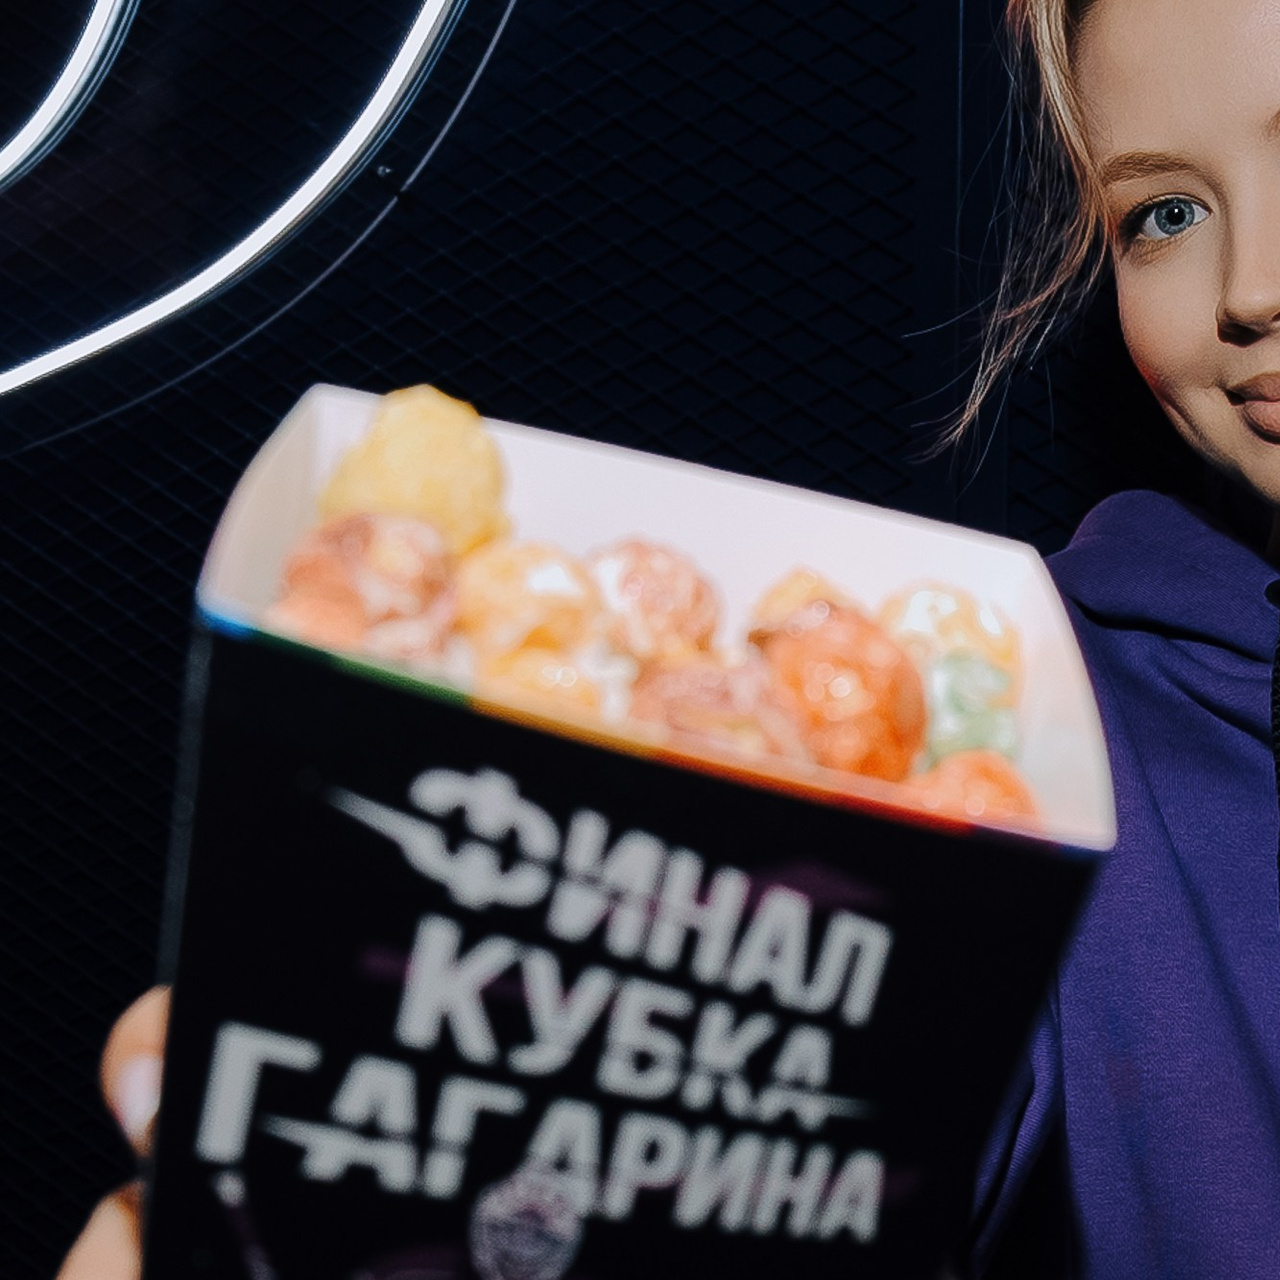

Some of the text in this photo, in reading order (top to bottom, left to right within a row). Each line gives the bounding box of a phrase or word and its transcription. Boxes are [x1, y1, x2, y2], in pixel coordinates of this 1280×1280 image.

[335, 766, 893, 1029] ФИНАЛ
[196, 1020, 887, 1245] ГАГАРИНА
[393, 912, 865, 1132] КУБКА
